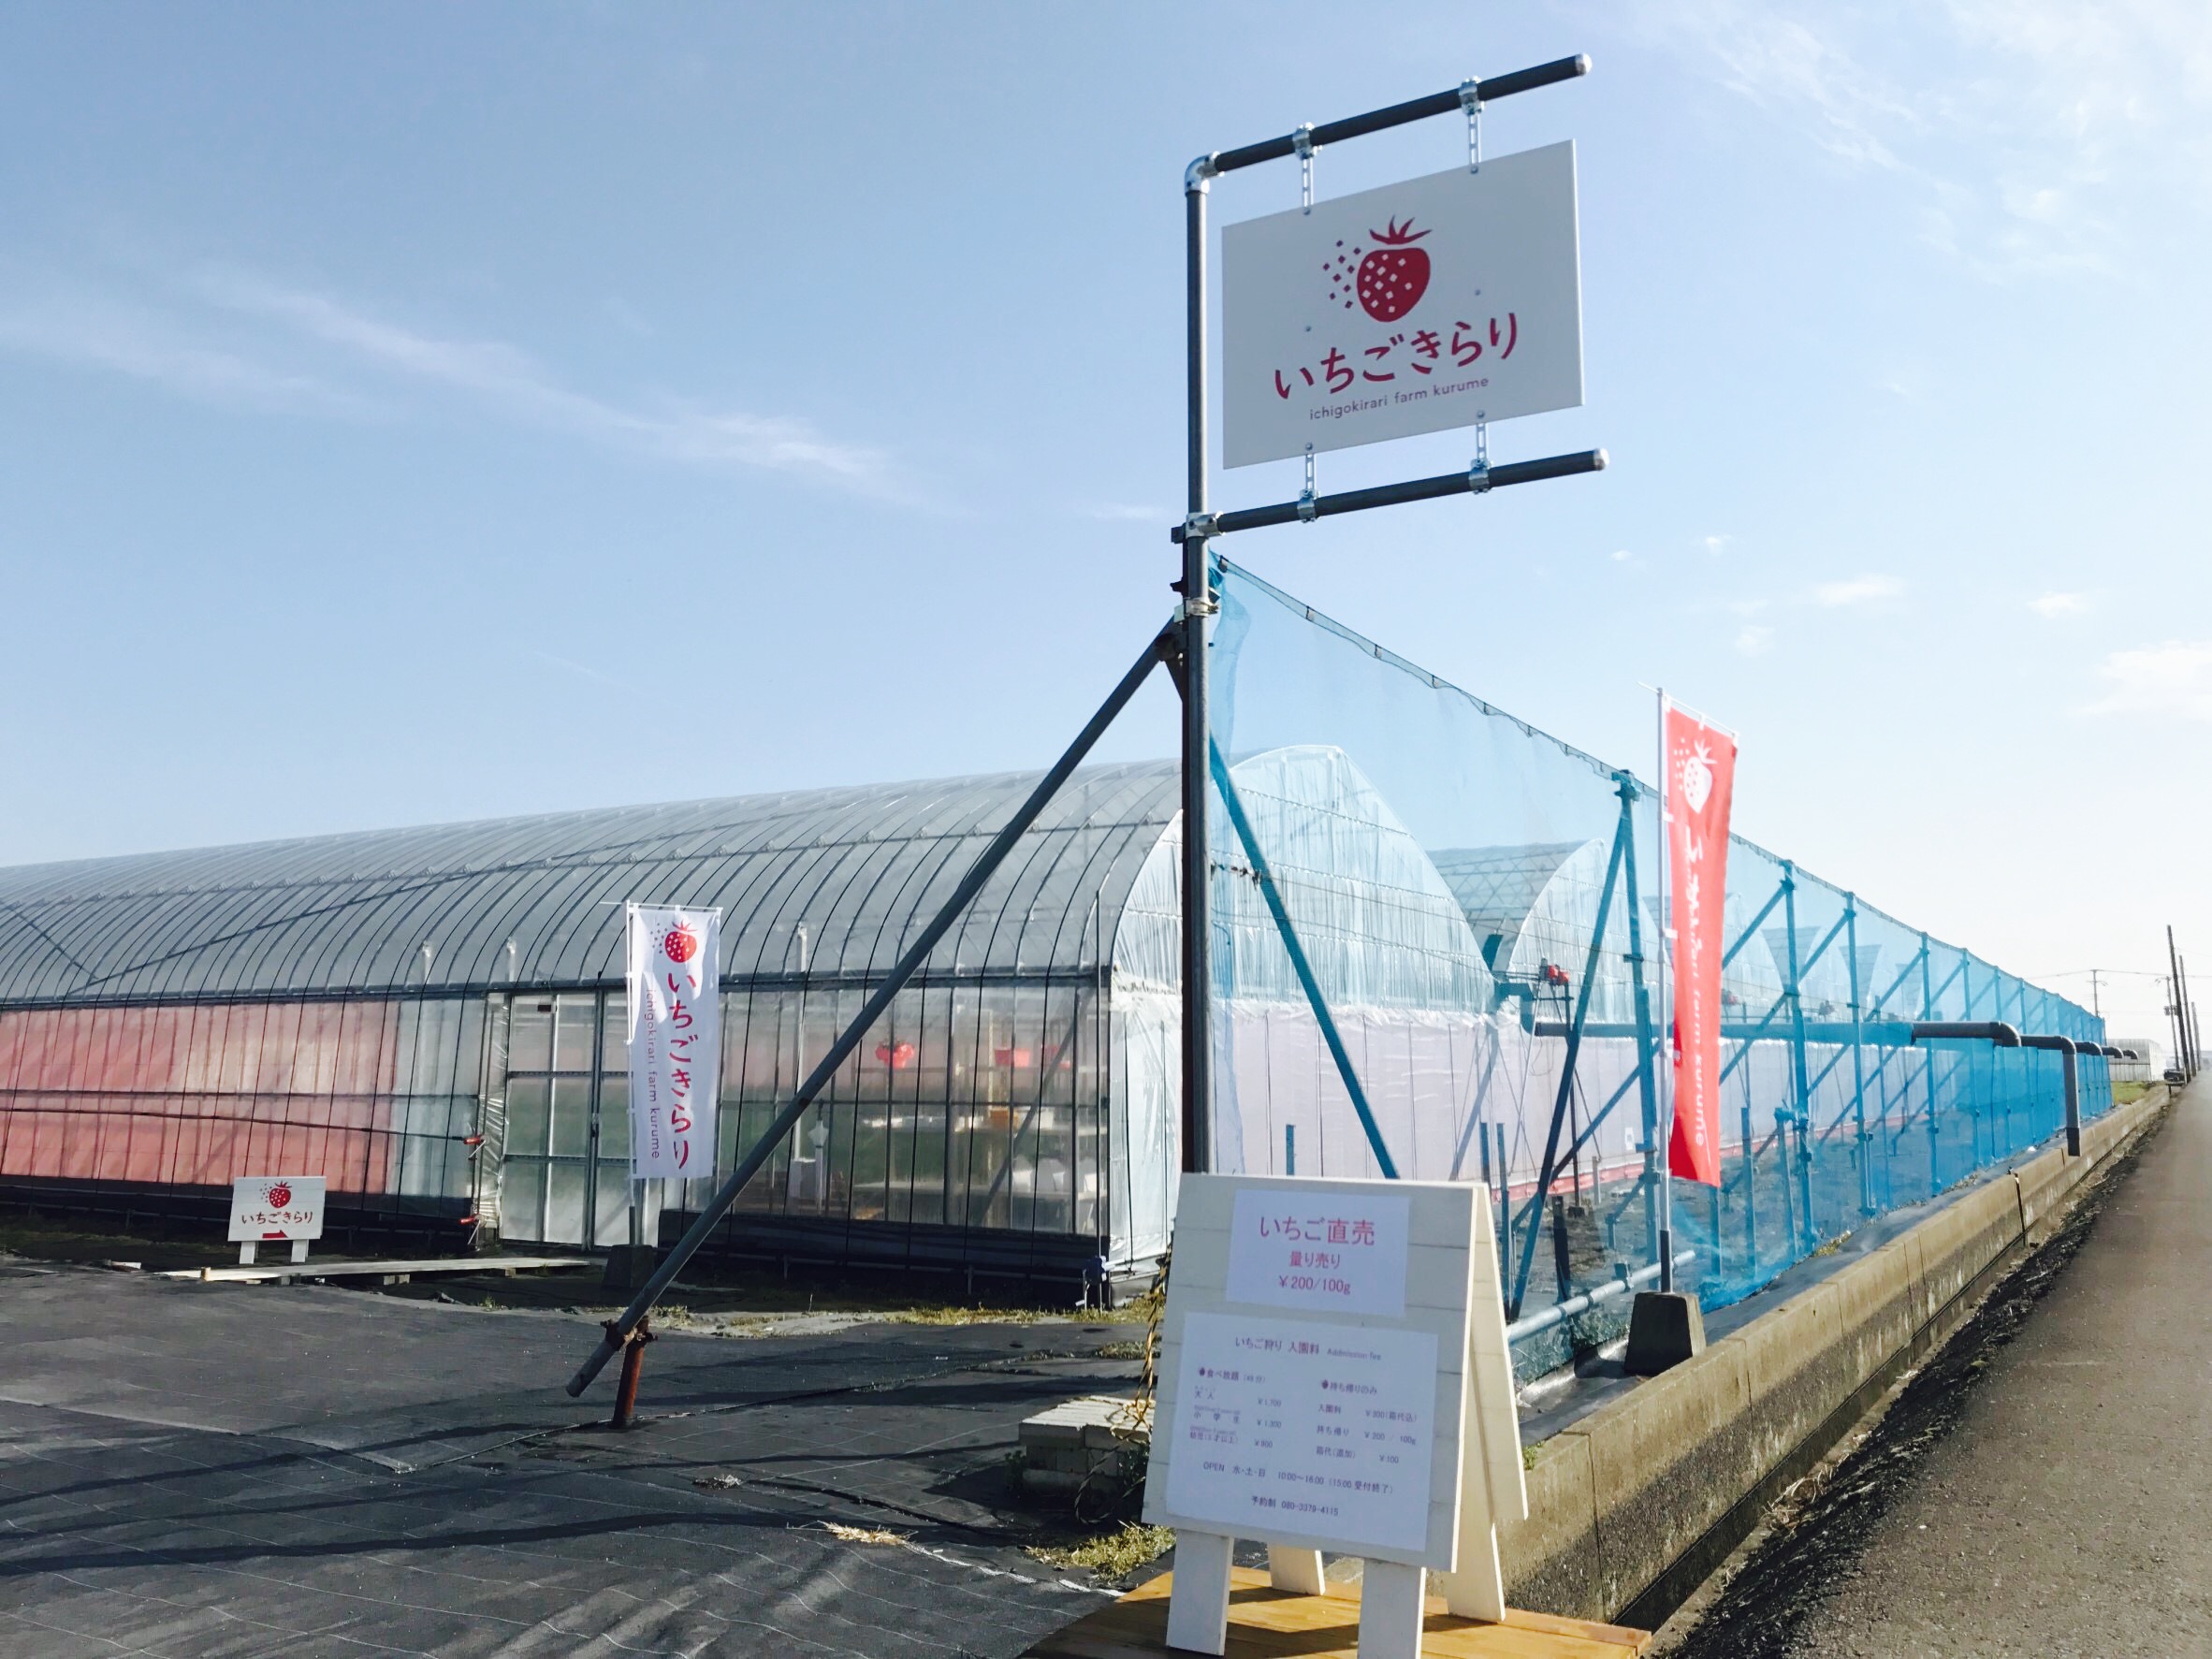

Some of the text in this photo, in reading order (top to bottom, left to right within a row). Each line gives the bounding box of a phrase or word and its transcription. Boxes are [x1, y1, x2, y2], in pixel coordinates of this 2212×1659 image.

[1274, 313, 1518, 400] いちごきらり
[1310, 377, 1489, 420] ichigokirari farm kurume
[644, 989, 661, 1159] ichigokirari farm kurume
[667, 972, 699, 1170] いちごきらり
[1695, 1055, 1705, 1146] kurume
[241, 1211, 313, 1225] いちごきらり
[1260, 1215, 1375, 1246] いちご直売
[1288, 1250, 1341, 1270] 量り売り
[1235, 1337, 1282, 1351] いちご狩り
[1288, 1341, 1319, 1355] 入園料
[1203, 1462, 1225, 1472] OPEN
